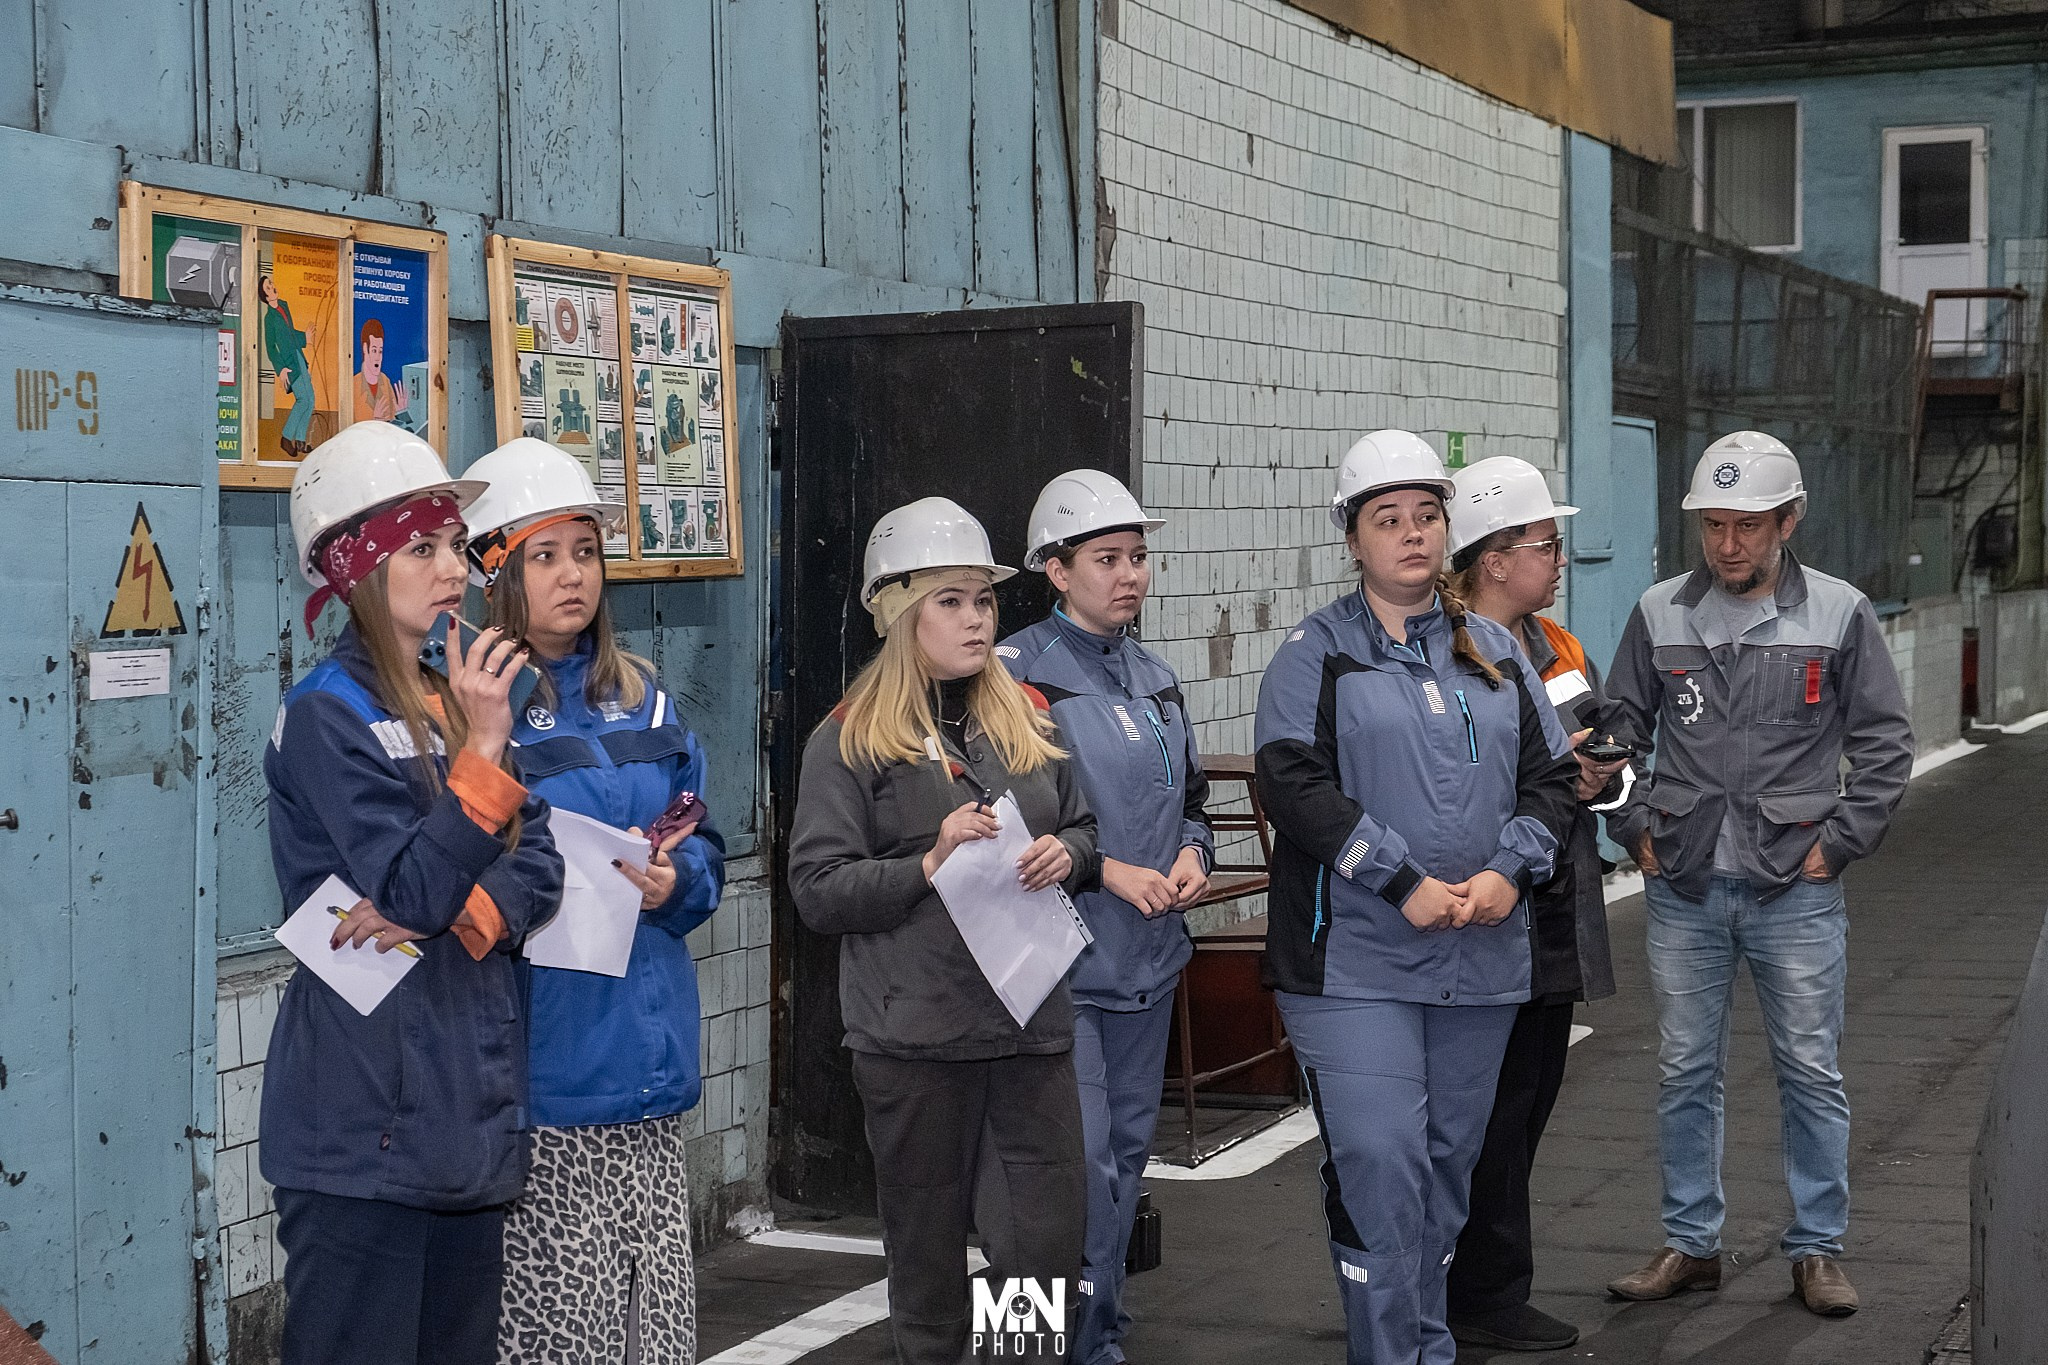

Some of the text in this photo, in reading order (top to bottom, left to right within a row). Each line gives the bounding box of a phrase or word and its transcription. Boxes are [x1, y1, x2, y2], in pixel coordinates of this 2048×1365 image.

[277, 254, 335, 269] К ОБОРВАННОМУ
[360, 253, 392, 265] ОТКРЫВАЙ
[304, 272, 336, 284] ПРОВОДУ
[354, 265, 411, 280] ЛЕММНУЮ КОРОБКУ
[354, 278, 406, 292] РИ РАБОТАЮЩЕМ
[299, 286, 322, 298] БЛИЖЕ
[354, 290, 410, 305] ЛЕКТРОДВИГАТЕЛЕ
[218, 395, 239, 404] АБОТЫ
[218, 408, 239, 419] ЮЧИ
[218, 425, 239, 434] ОВКУ
[218, 440, 239, 450] АКАТ
